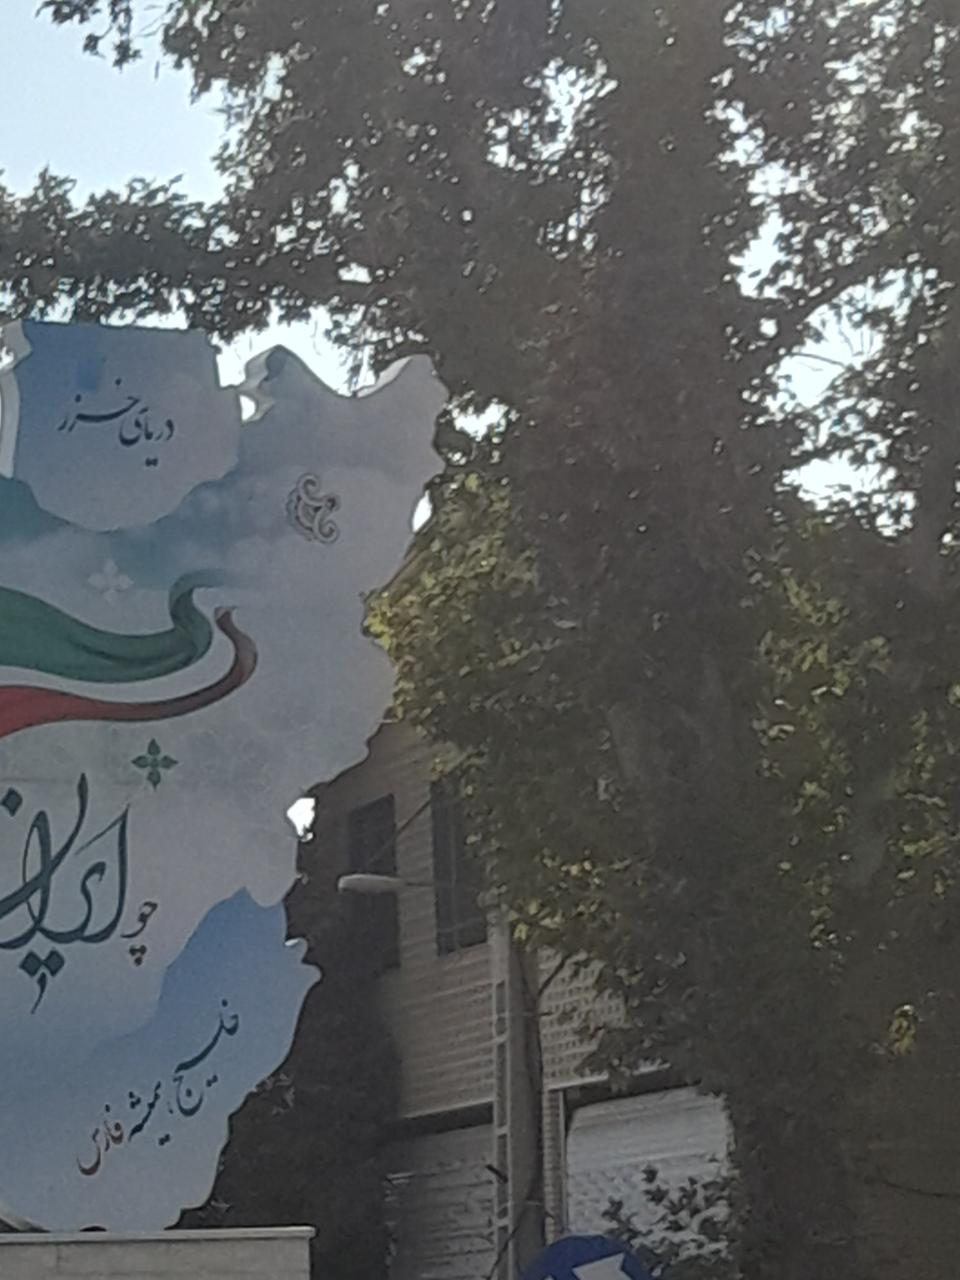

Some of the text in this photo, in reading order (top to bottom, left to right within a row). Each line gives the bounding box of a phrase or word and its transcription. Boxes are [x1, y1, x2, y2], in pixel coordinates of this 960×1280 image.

[56, 377, 176, 467] دریای خزر
[119, 900, 159, 966] چو
[172, 998, 240, 1118] خلیج
[75, 1103, 125, 1177] فارس
